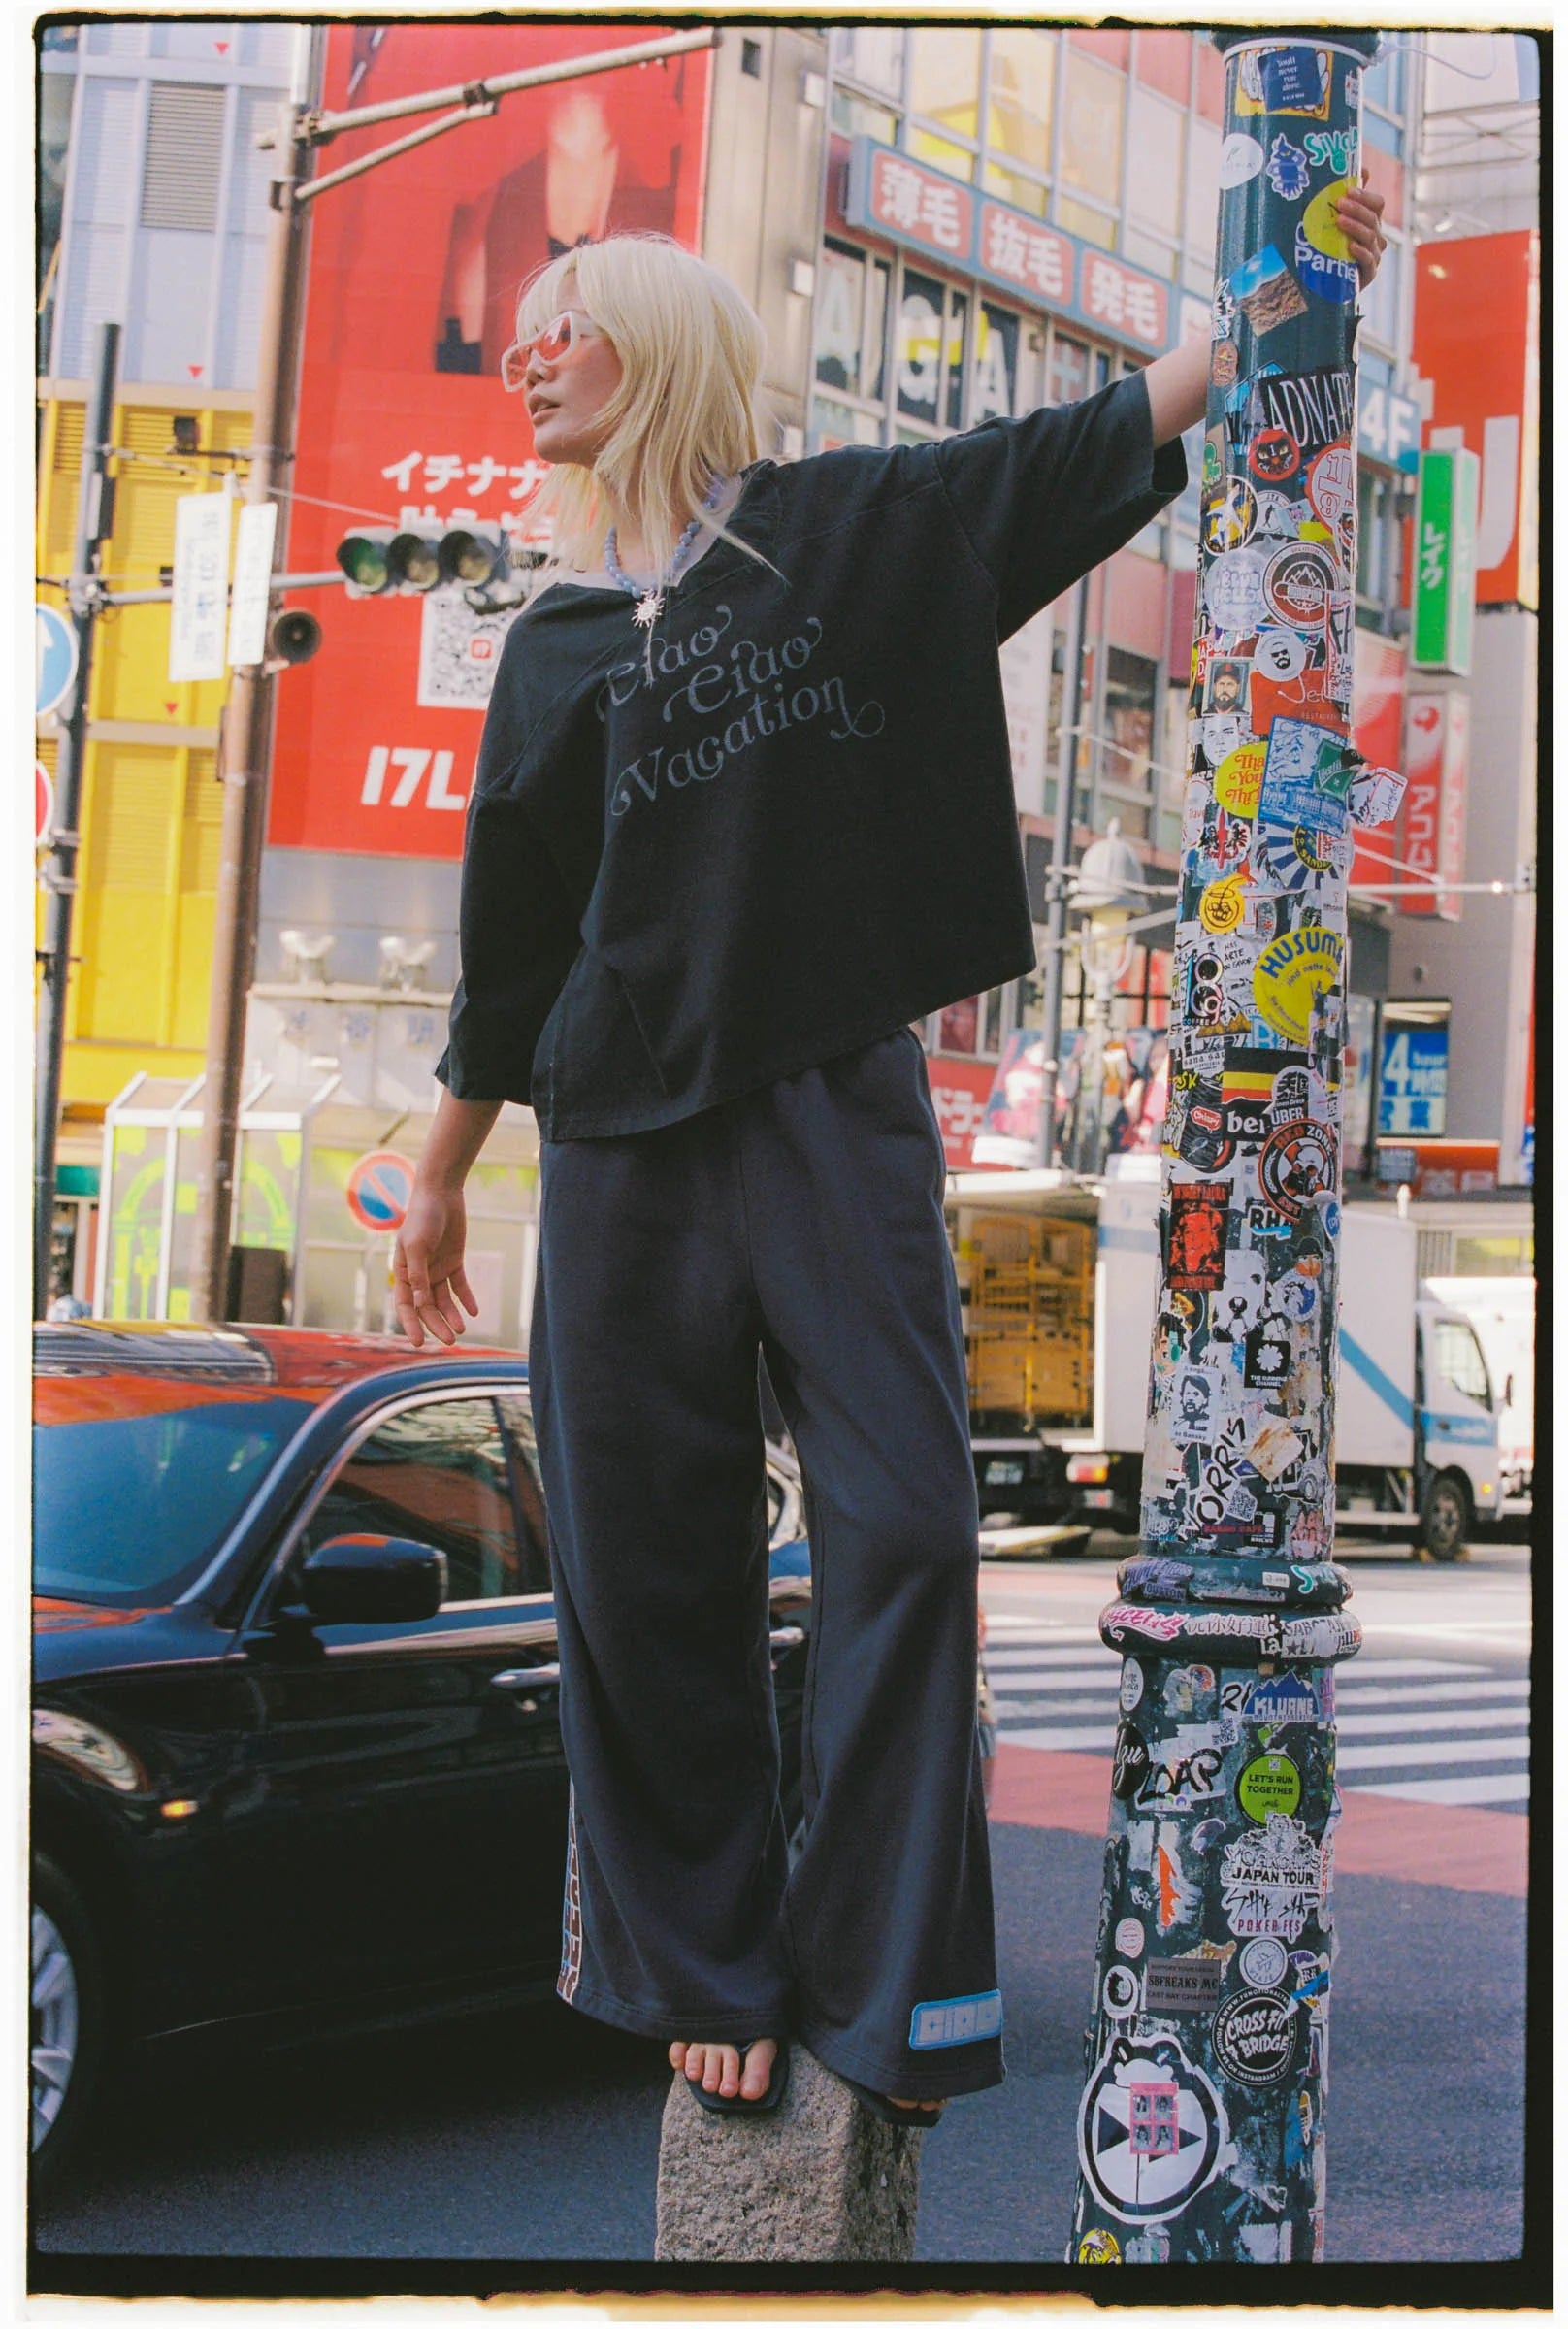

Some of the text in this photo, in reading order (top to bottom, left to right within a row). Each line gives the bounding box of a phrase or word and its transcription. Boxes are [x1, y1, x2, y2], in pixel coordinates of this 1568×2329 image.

[1294, 245, 1358, 282] Partie
[1360, 388, 1414, 459] 4F
[1421, 522, 1446, 590] レイク
[596, 605, 732, 722] Ciao
[662, 617, 823, 722] Ciao
[611, 676, 885, 816] Vacation
[1247, 1785, 1294, 1795] TOGETHER
[1249, 1774, 1293, 1785] LET'S RUN
[1233, 1868, 1314, 1885] JAPAN TOUR
[1201, 1977, 1219, 1990] MC
[1238, 2035, 1290, 2058] BRIDGE
